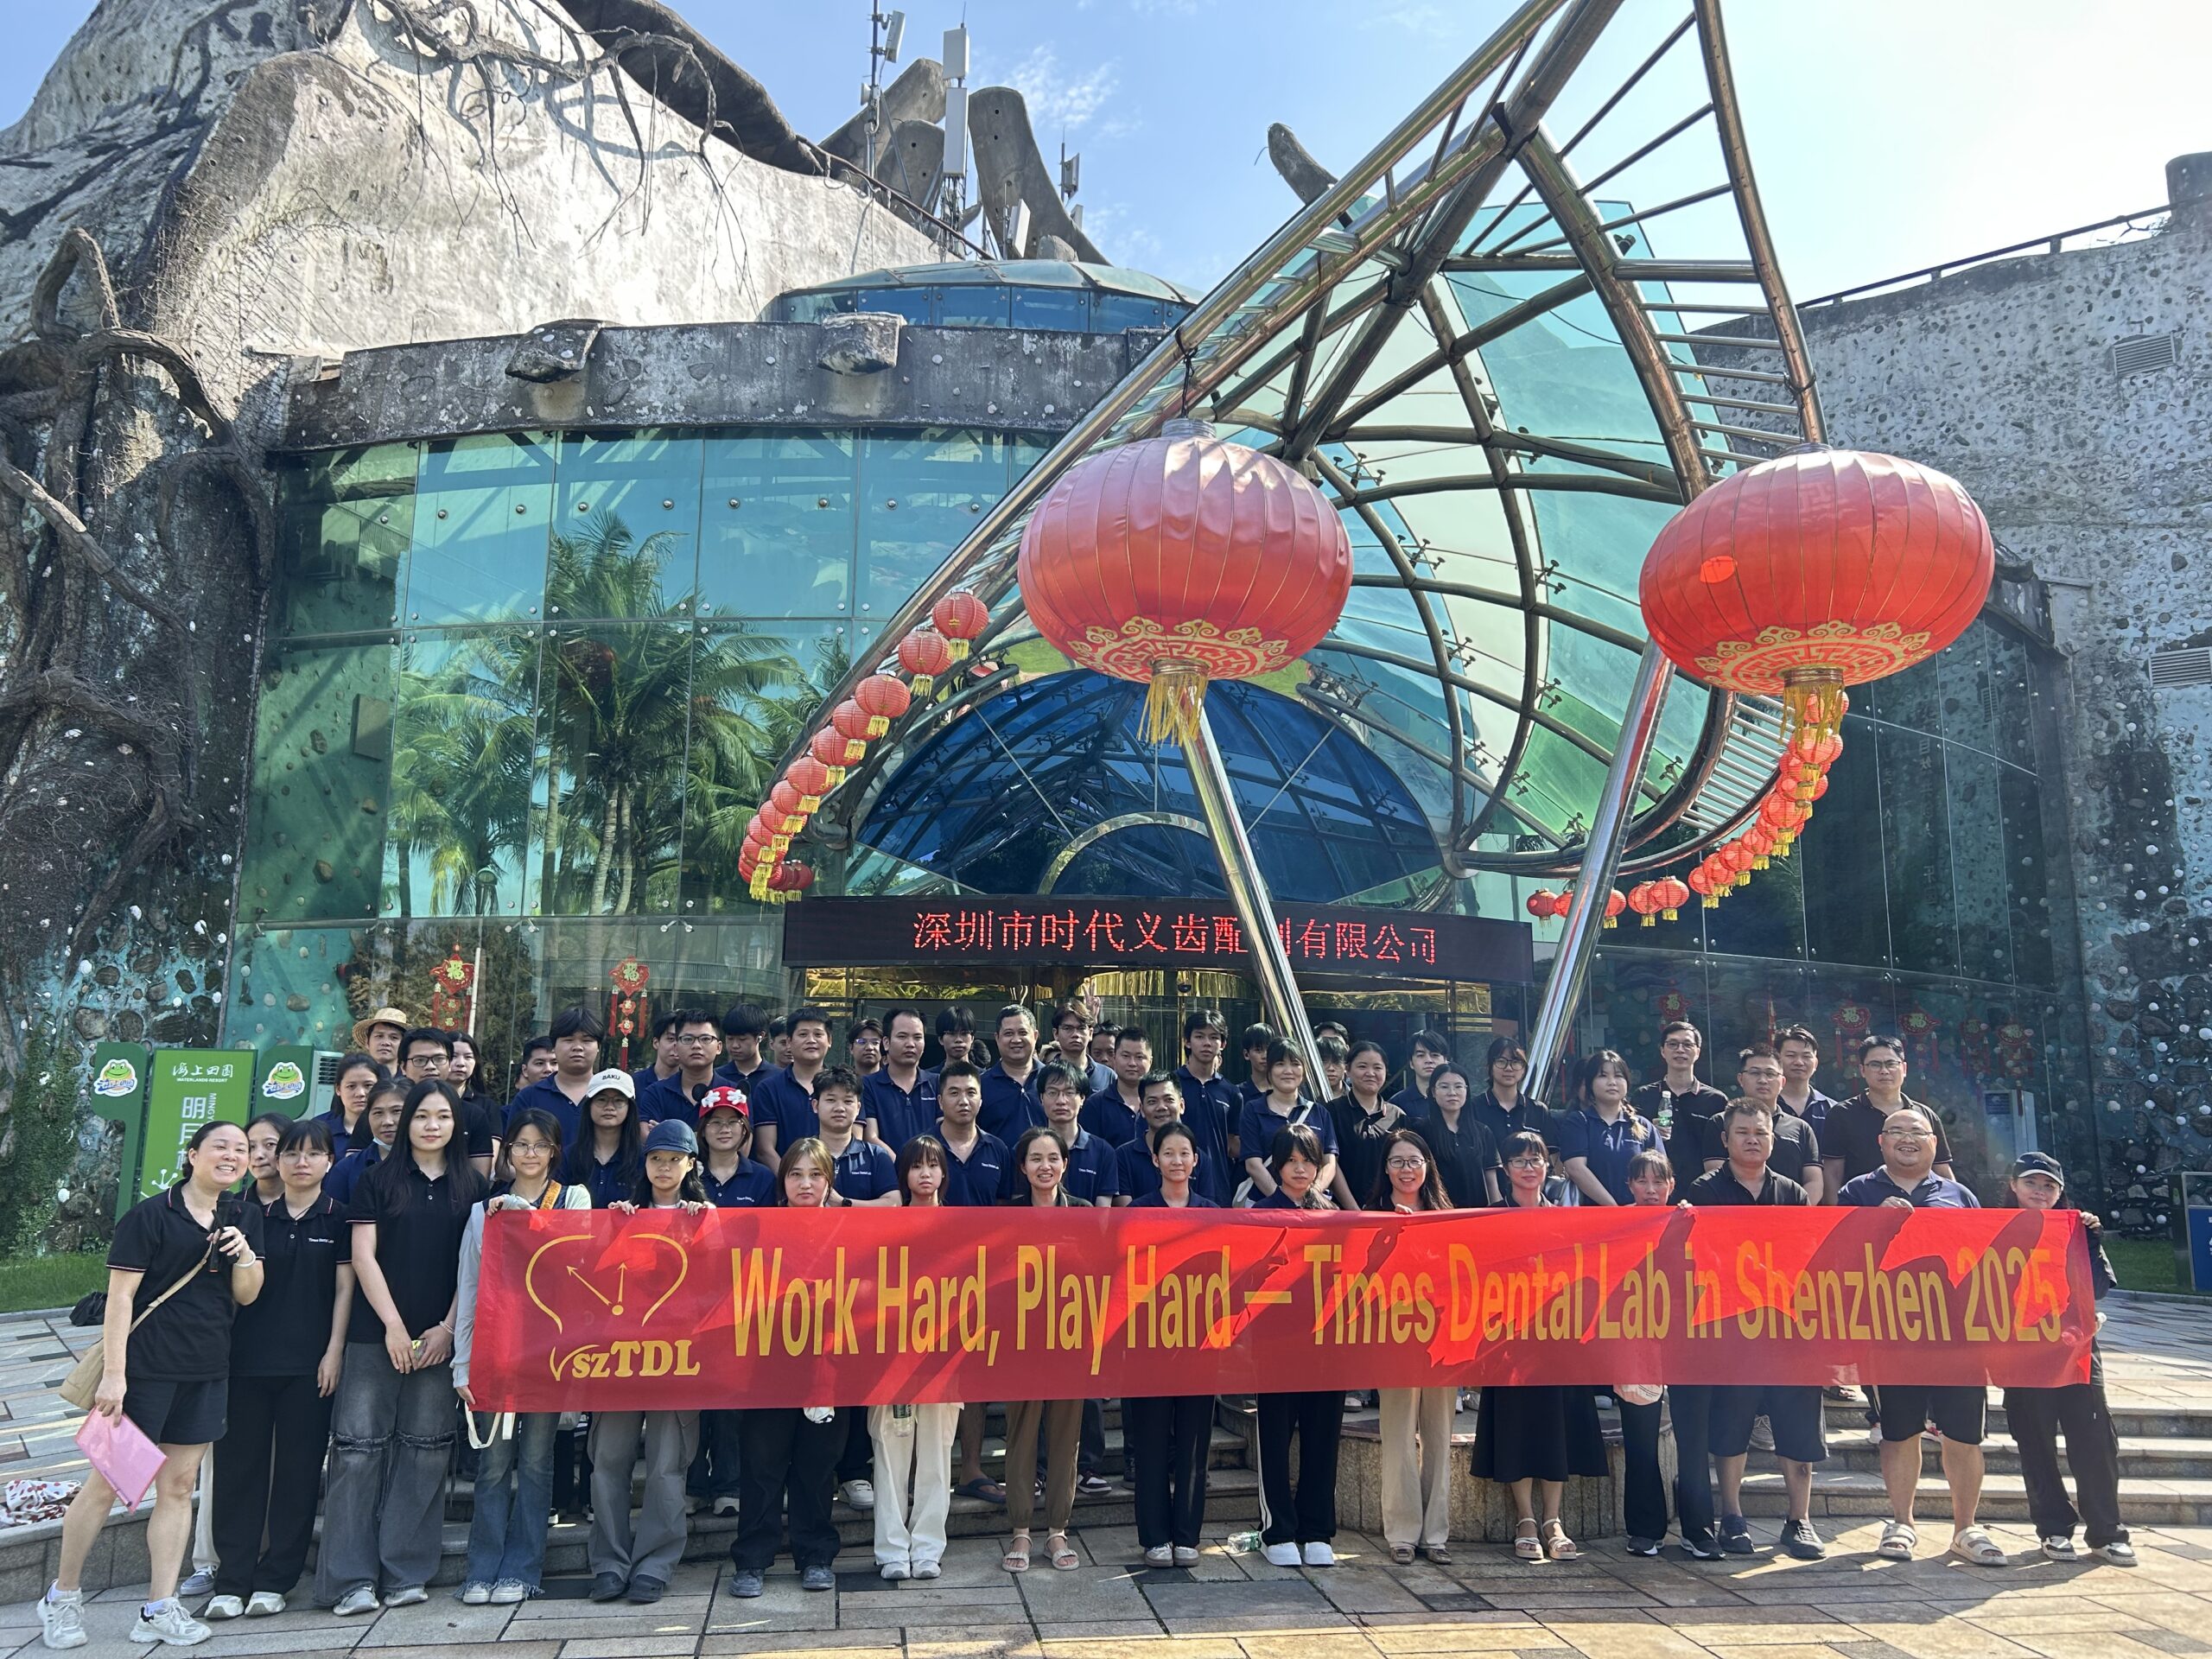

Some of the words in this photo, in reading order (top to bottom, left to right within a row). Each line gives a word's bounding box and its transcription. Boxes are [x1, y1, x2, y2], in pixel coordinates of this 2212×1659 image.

[207, 1092, 217, 1123] MINGY
[732, 1247, 859, 1357] Work
[877, 1245, 1001, 1367] Hard,
[1017, 1244, 1111, 1376] Play
[1127, 1245, 1231, 1349] Hard
[1304, 1243, 1435, 1345] Times
[1449, 1243, 1584, 1344] Dental
[1599, 1243, 1670, 1339] Lab
[1686, 1243, 1721, 1339] in
[1736, 1240, 1950, 1342] Shenzhen
[1958, 1247, 2062, 1343] 2025
